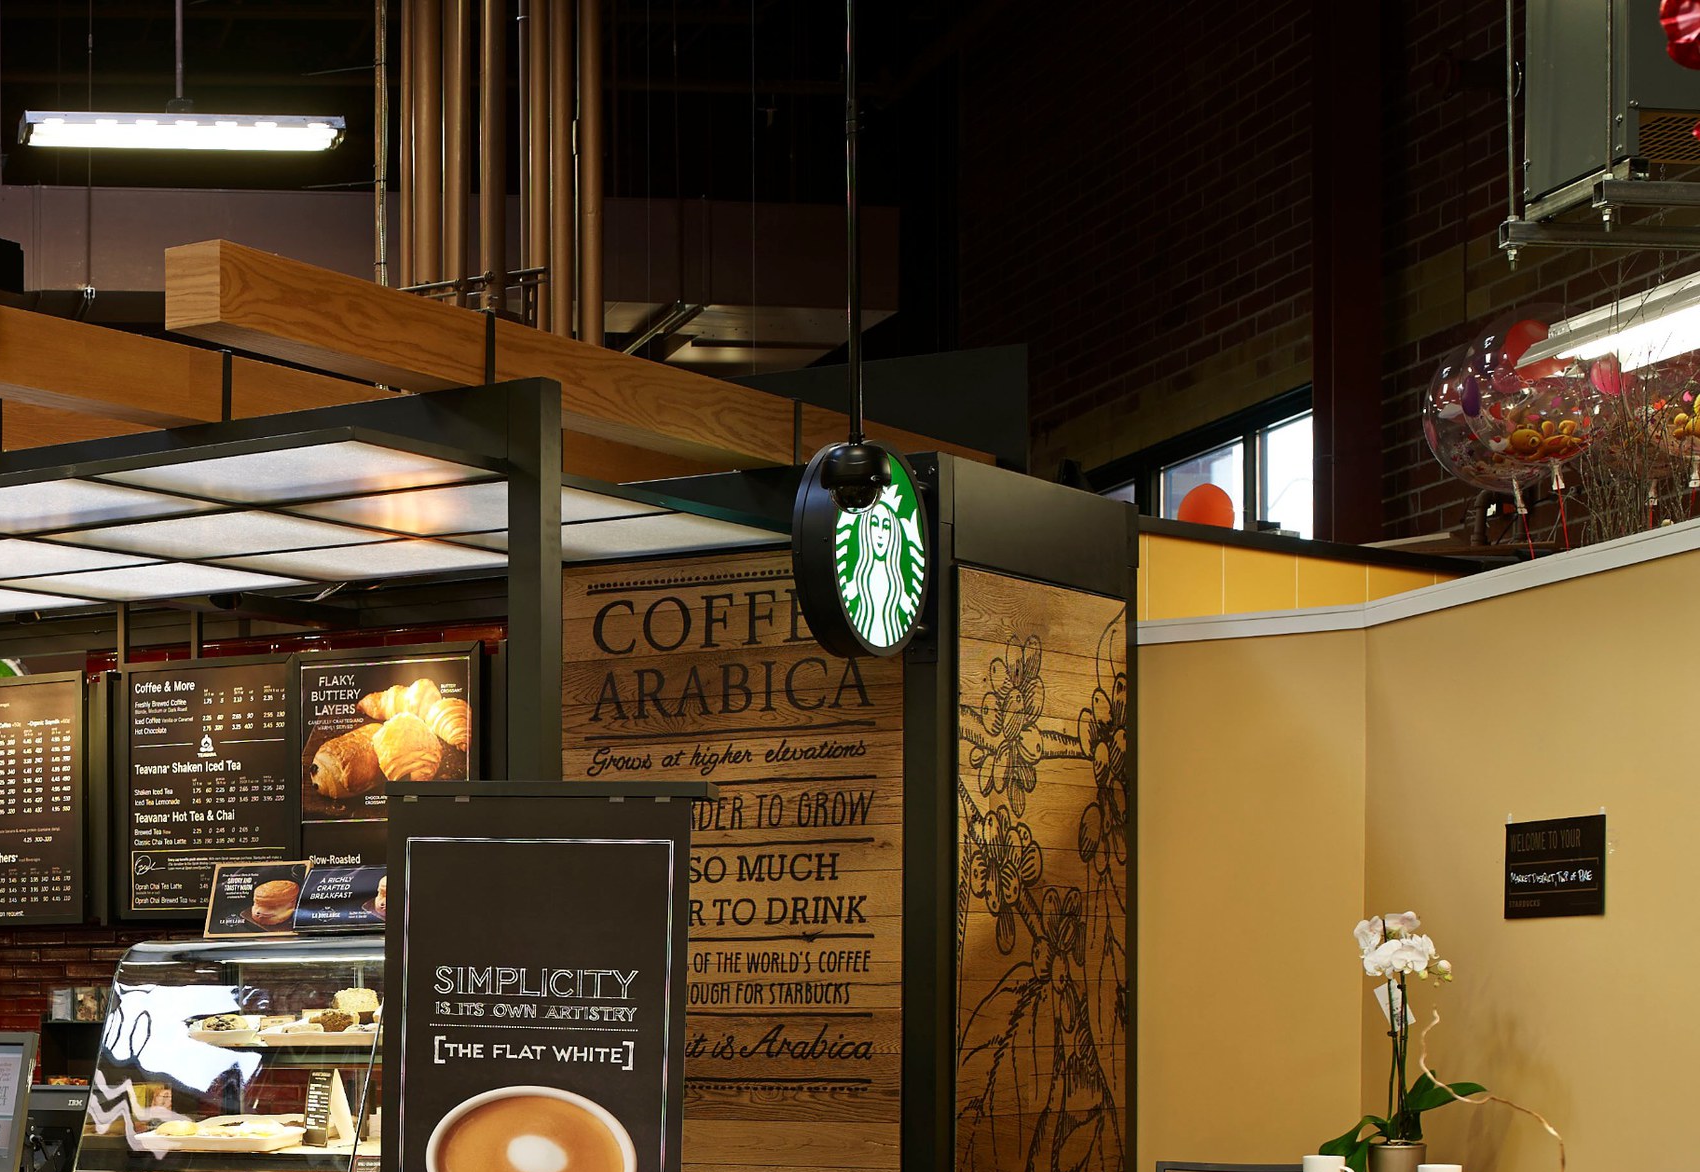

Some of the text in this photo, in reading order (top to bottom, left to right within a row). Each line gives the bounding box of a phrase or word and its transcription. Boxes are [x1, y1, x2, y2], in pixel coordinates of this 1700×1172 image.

[135, 681, 195, 694] Coffee & More
[318, 675, 355, 687] FLAKY,
[588, 657, 874, 721] ARABICA
[311, 689, 361, 701] BUTTERY
[315, 704, 356, 716] LAYERS
[172, 762, 202, 773] Shaken
[205, 761, 224, 771] Iced
[226, 759, 241, 771] Tea
[587, 739, 866, 777] Grows at higher elevations
[172, 811, 187, 822] Hot
[189, 811, 204, 821] Tea
[206, 810, 214, 820] &
[216, 809, 235, 820] Chai
[756, 794, 783, 829] TO
[798, 790, 875, 827] GROW
[1510, 828, 1581, 853] WELCOME TO YOUR
[309, 853, 361, 865] Slow-Roasted
[737, 853, 840, 882] MUCH
[310, 891, 353, 900] BREAKFAST
[1509, 900, 1541, 908] STARBUCKS
[713, 898, 758, 926] TO
[764, 896, 868, 925] DRINK
[694, 950, 871, 974] OF THE WORLD'S COFFEE
[434, 965, 638, 1000] SIMPLICITY
[736, 983, 763, 1004] FOR
[769, 983, 850, 1004] STARBUCKS
[435, 1001, 638, 1022] IS ITS OWN ARTISTRY
[493, 1044, 546, 1060] FLAT
[740, 1024, 874, 1060] Arabica
